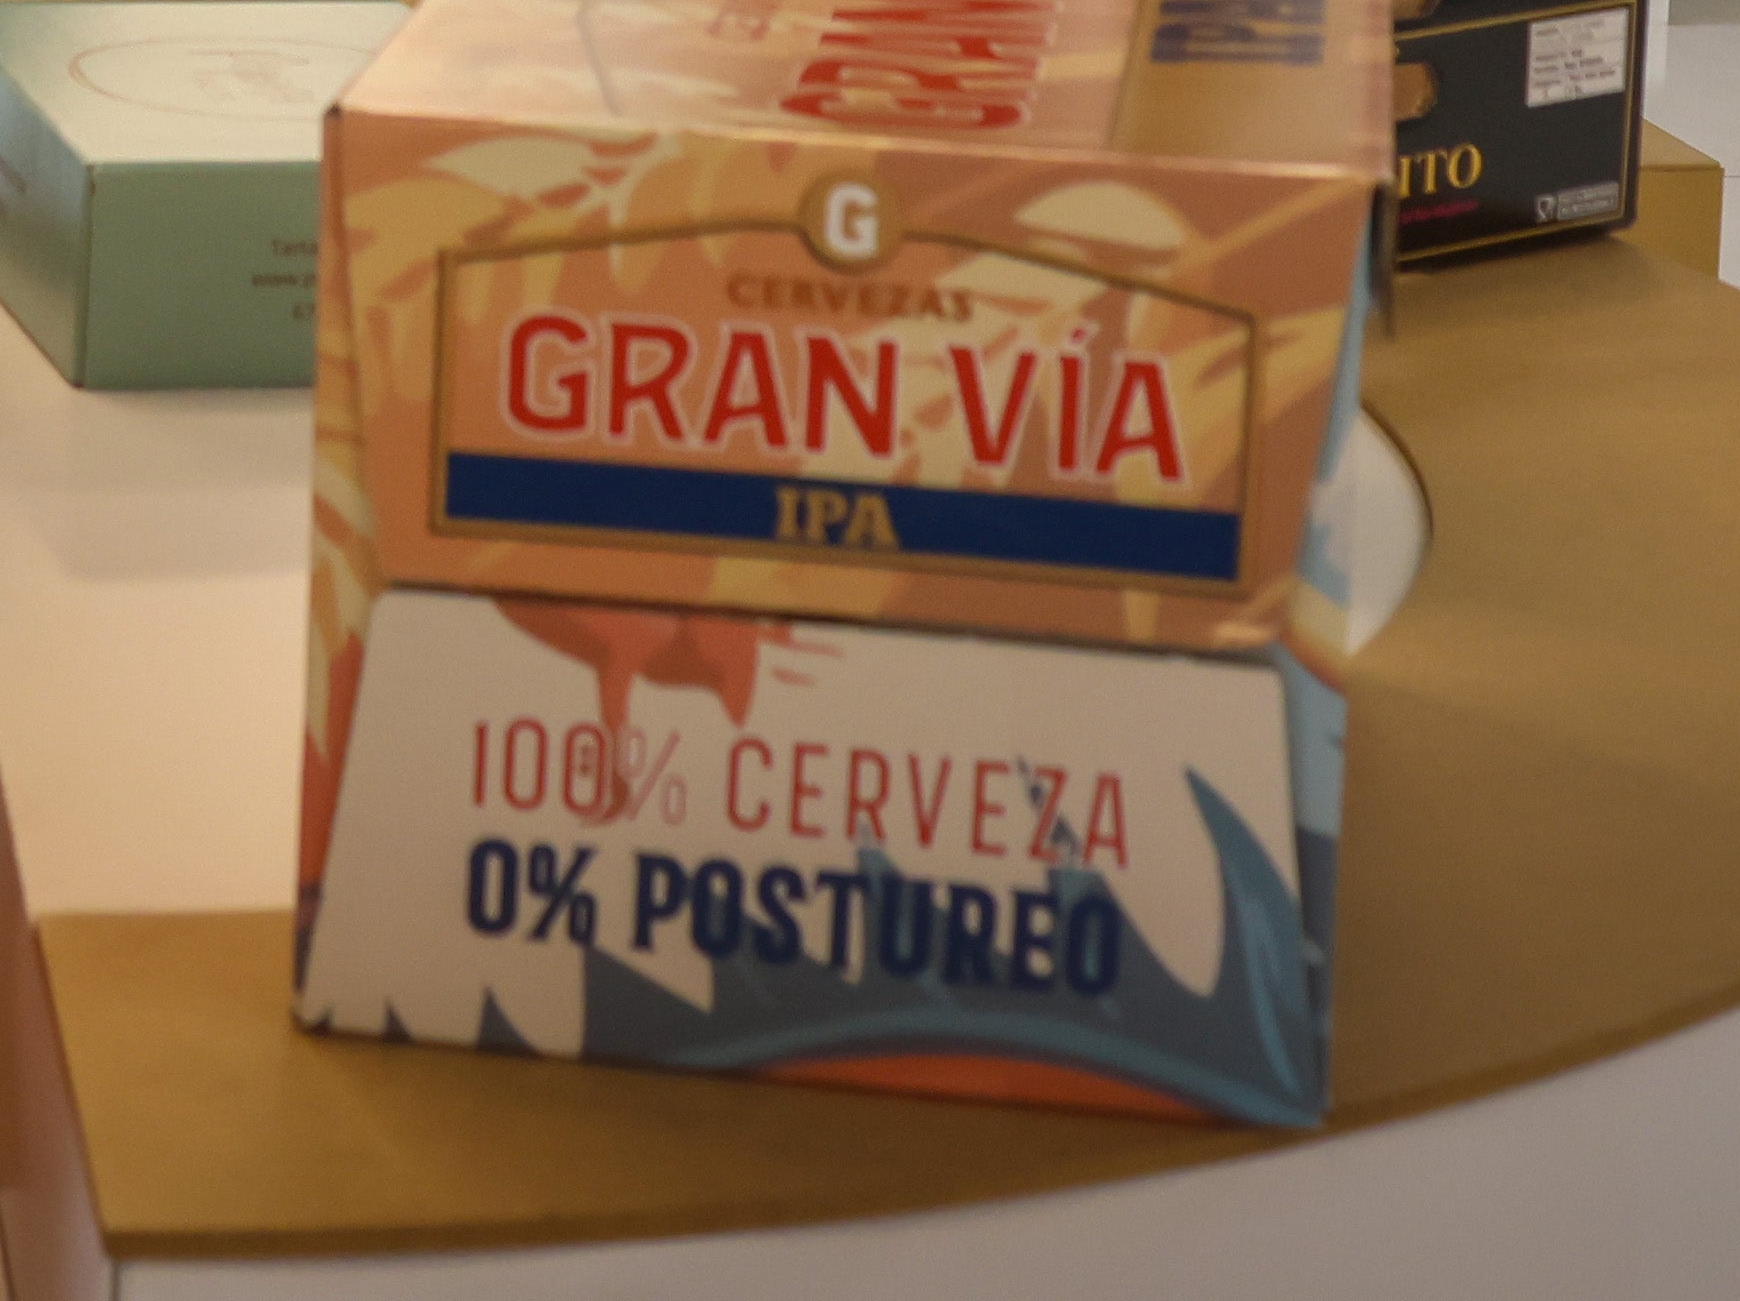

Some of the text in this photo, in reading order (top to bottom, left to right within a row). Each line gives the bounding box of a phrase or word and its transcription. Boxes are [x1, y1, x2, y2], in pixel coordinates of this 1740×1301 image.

[824, 182, 880, 257] G
[725, 272, 973, 323] CERVEZAS
[503, 311, 1189, 487] GRAN VÍA
[773, 485, 900, 551] IPA
[471, 715, 1132, 868] 100% CERVEZA
[465, 837, 1122, 998] 0% POSTUREO
